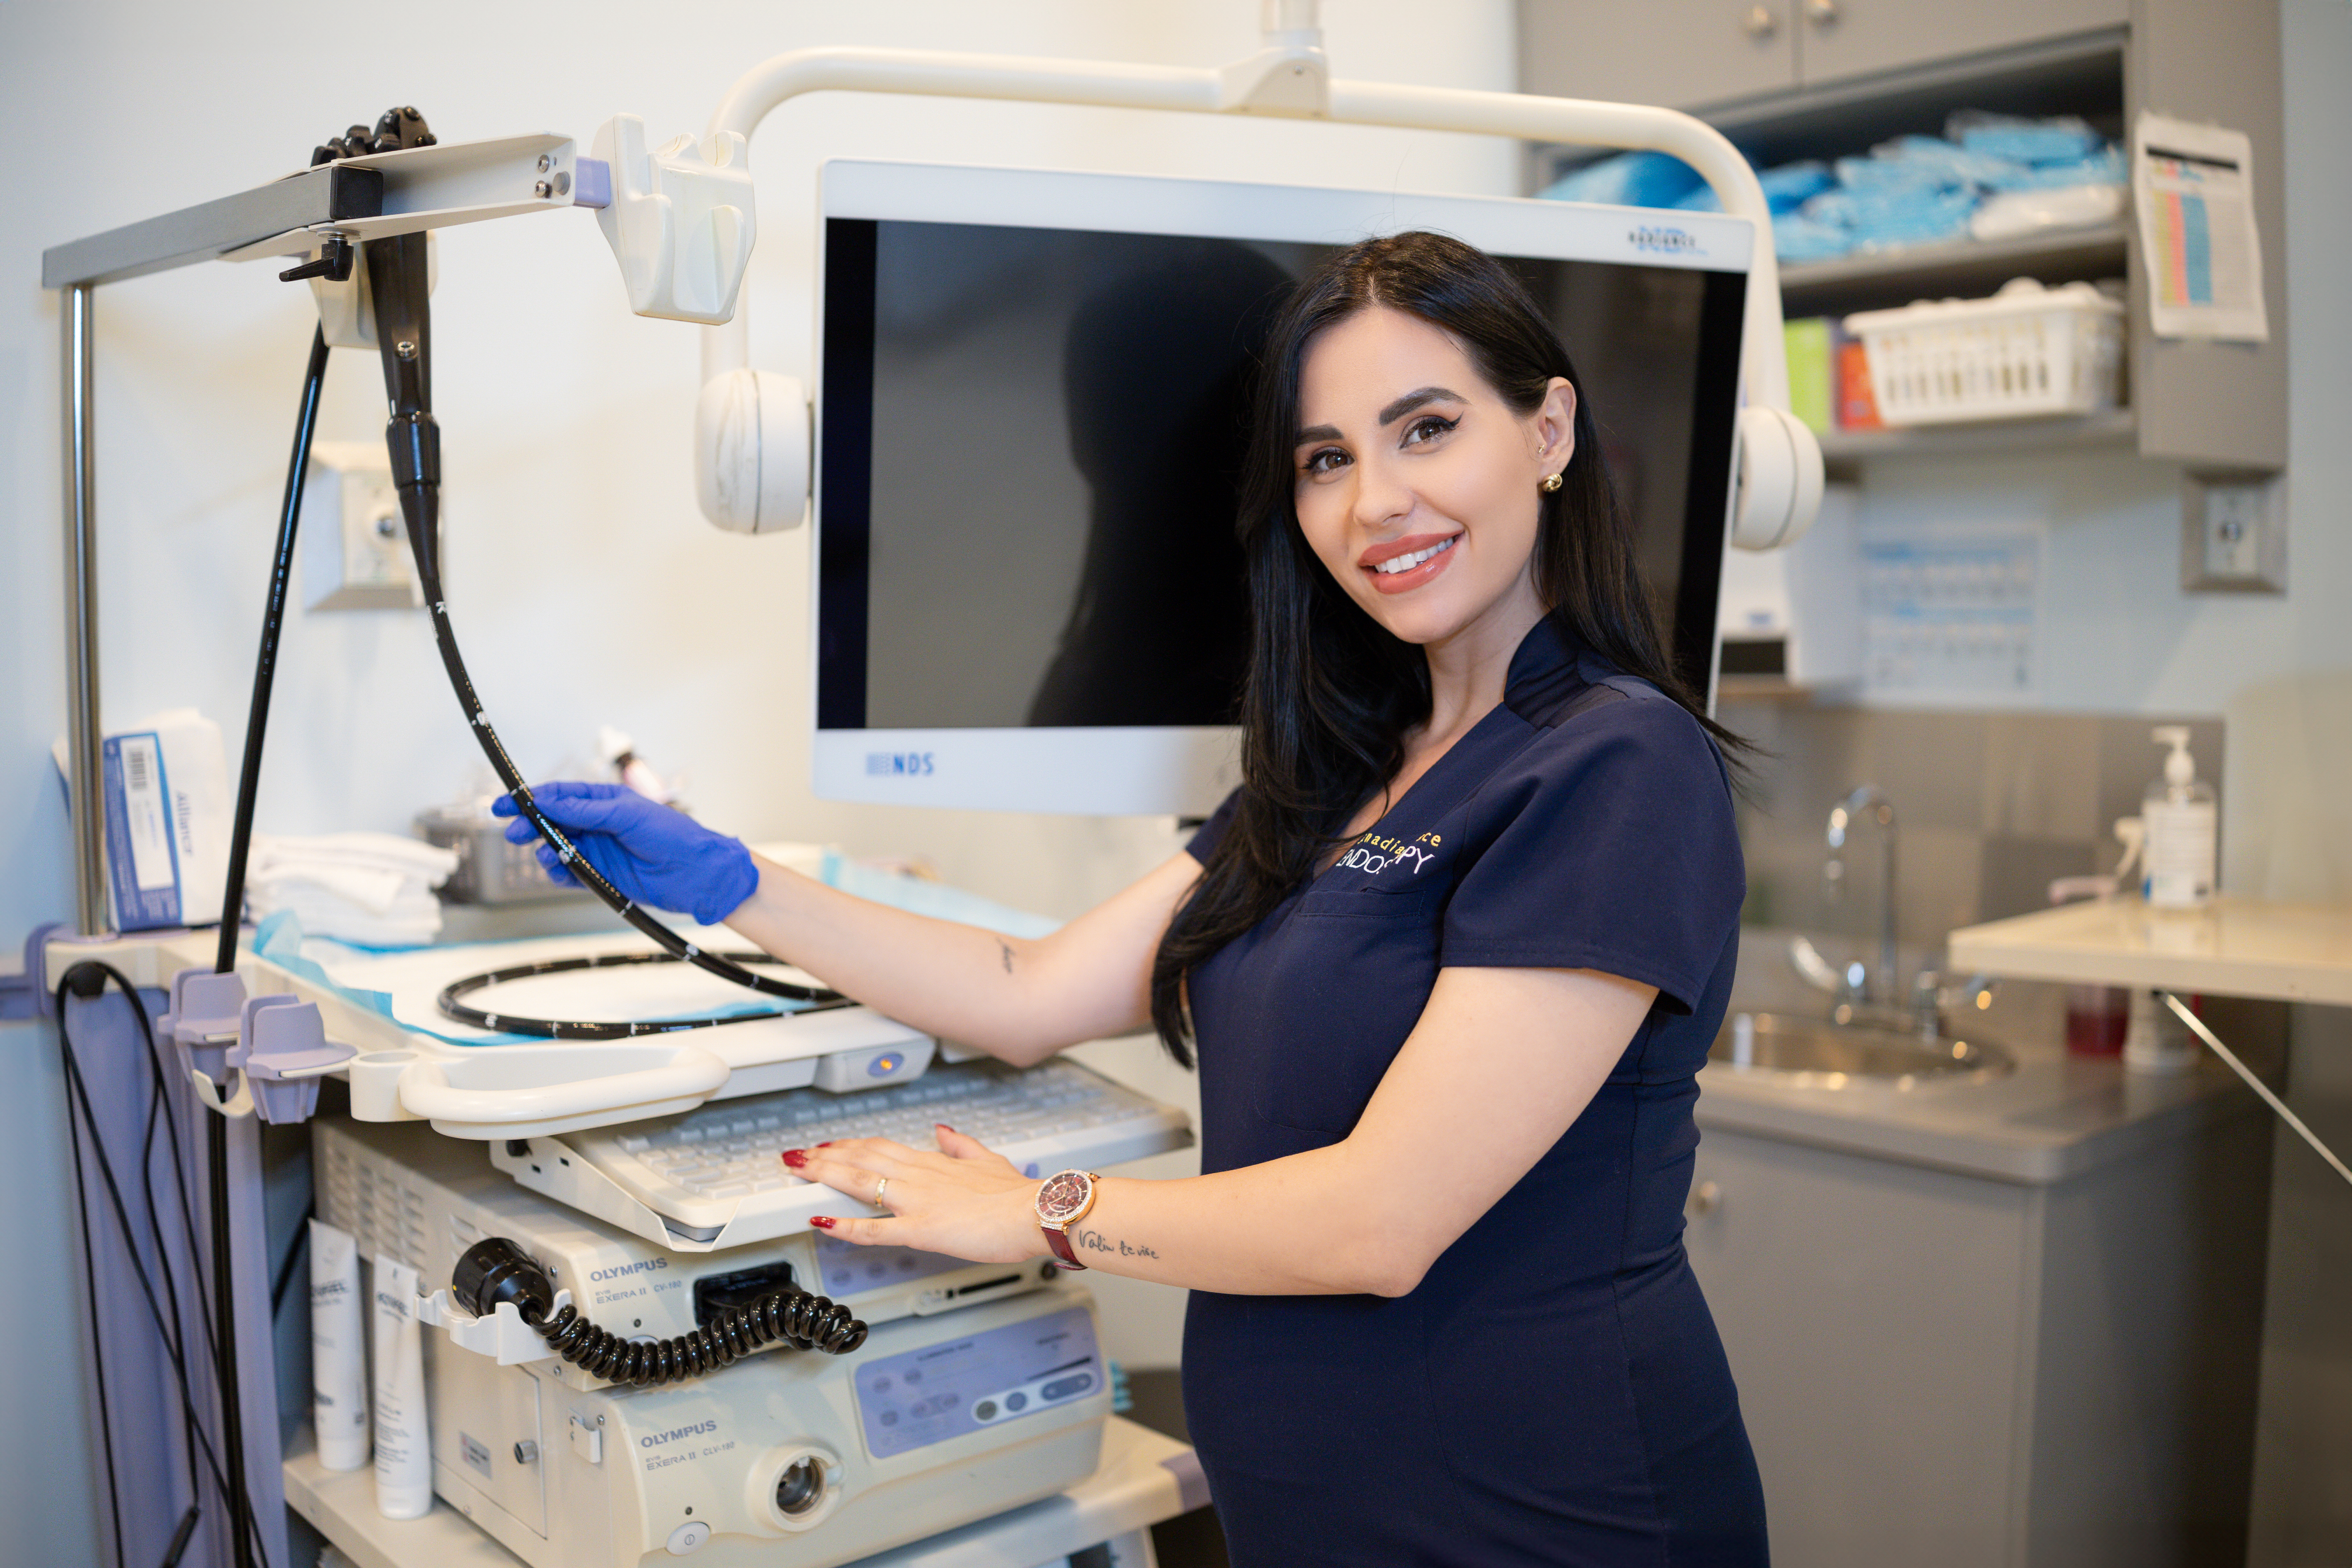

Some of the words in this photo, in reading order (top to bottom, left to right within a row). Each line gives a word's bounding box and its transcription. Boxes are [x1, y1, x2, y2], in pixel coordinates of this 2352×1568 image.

[892, 752, 935, 775] NDS
[590, 1258, 668, 1282] OLYMPUS
[596, 1290, 637, 1304] EXERA
[640, 1420, 718, 1448] OLYMPUS
[646, 1455, 687, 1471] EXERA
